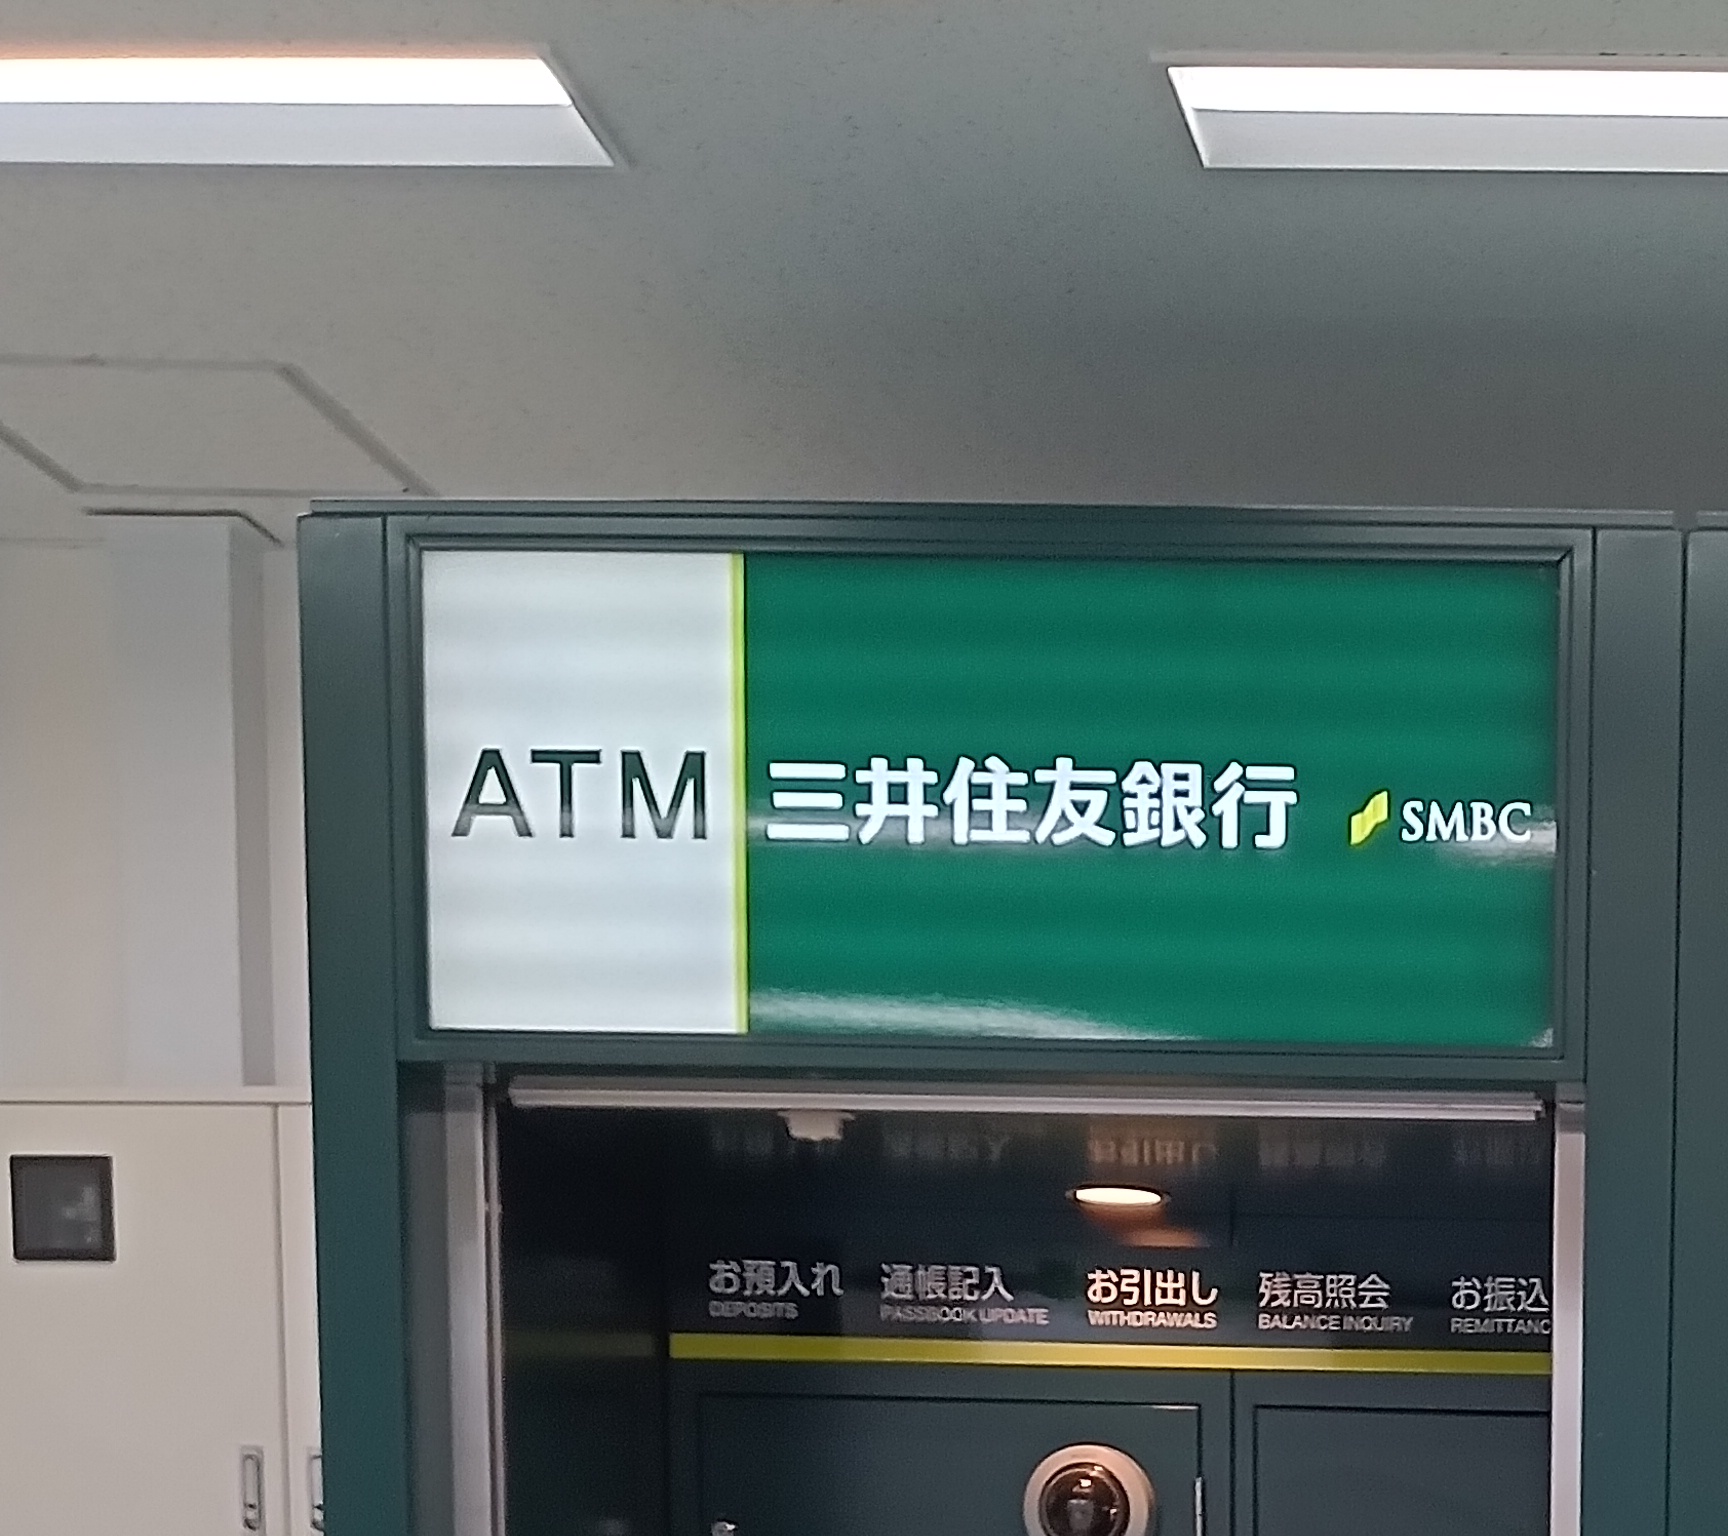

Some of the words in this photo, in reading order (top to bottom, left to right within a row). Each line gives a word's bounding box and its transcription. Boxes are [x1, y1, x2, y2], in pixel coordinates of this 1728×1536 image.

[450, 748, 709, 840] ATM
[765, 756, 1298, 851] 三井住友銀行
[1400, 798, 1533, 844] SMBC
[708, 1259, 845, 1298] お預入れ
[880, 1262, 1015, 1302] 通帳記入
[1086, 1269, 1219, 1307] お引出し
[1258, 1271, 1392, 1310] 残高照会
[1450, 1276, 1550, 1312] お振込
[708, 1301, 800, 1320] DEPOSITS
[979, 1307, 1050, 1325] UPDATE
[1087, 1309, 1218, 1329] WITHDRAWALS
[1258, 1312, 1342, 1330] BALANCE
[1343, 1315, 1414, 1333] INQUIRY
